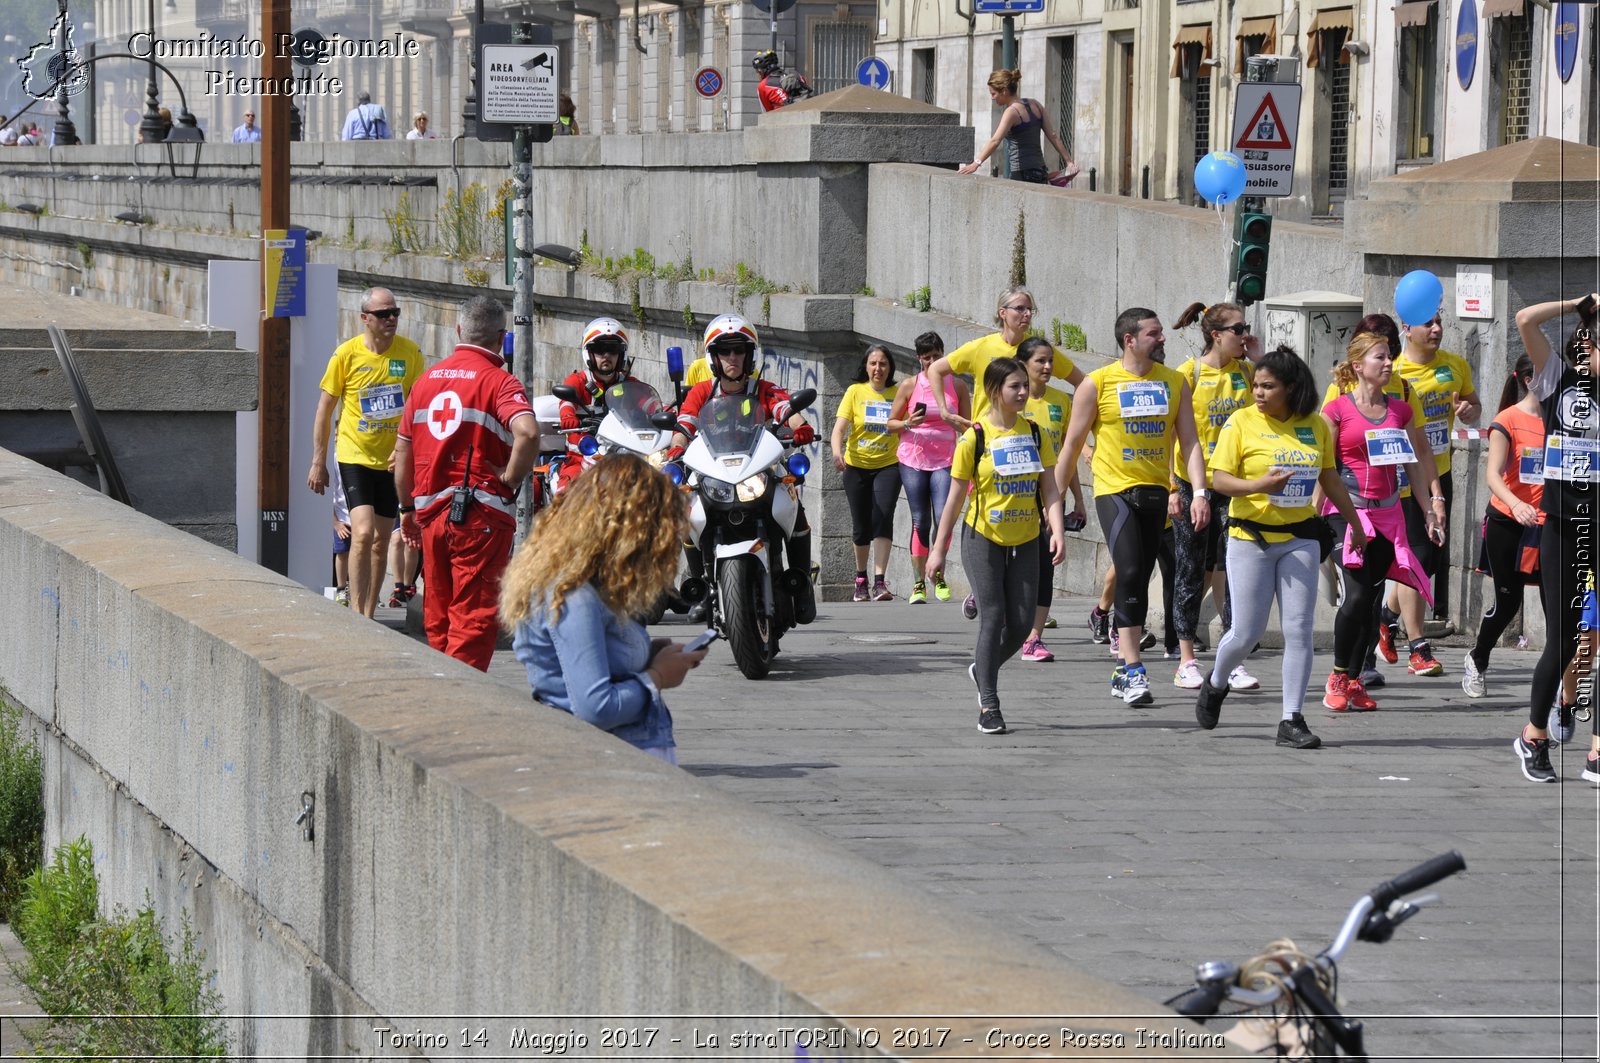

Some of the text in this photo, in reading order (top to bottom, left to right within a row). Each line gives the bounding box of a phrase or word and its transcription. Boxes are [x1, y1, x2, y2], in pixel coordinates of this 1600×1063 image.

[490, 63, 514, 73] AREA
[489, 75, 550, 84] VIDEOSORVEGLIATA
[1244, 163, 1292, 172] ssuasore
[428, 369, 477, 380] CROCE ROSSA ITALIANA
[369, 394, 396, 412] 5074
[1132, 394, 1156, 407] 2861
[1208, 413, 1232, 427] TOR
[1123, 421, 1166, 435] TORINO
[1137, 448, 1164, 456] REALE
[1382, 441, 1403, 455] 4411
[1006, 450, 1031, 464] 4663
[993, 480, 1037, 496] TORINO
[1282, 484, 1306, 497] 4661
[262, 511, 285, 521] MSS
